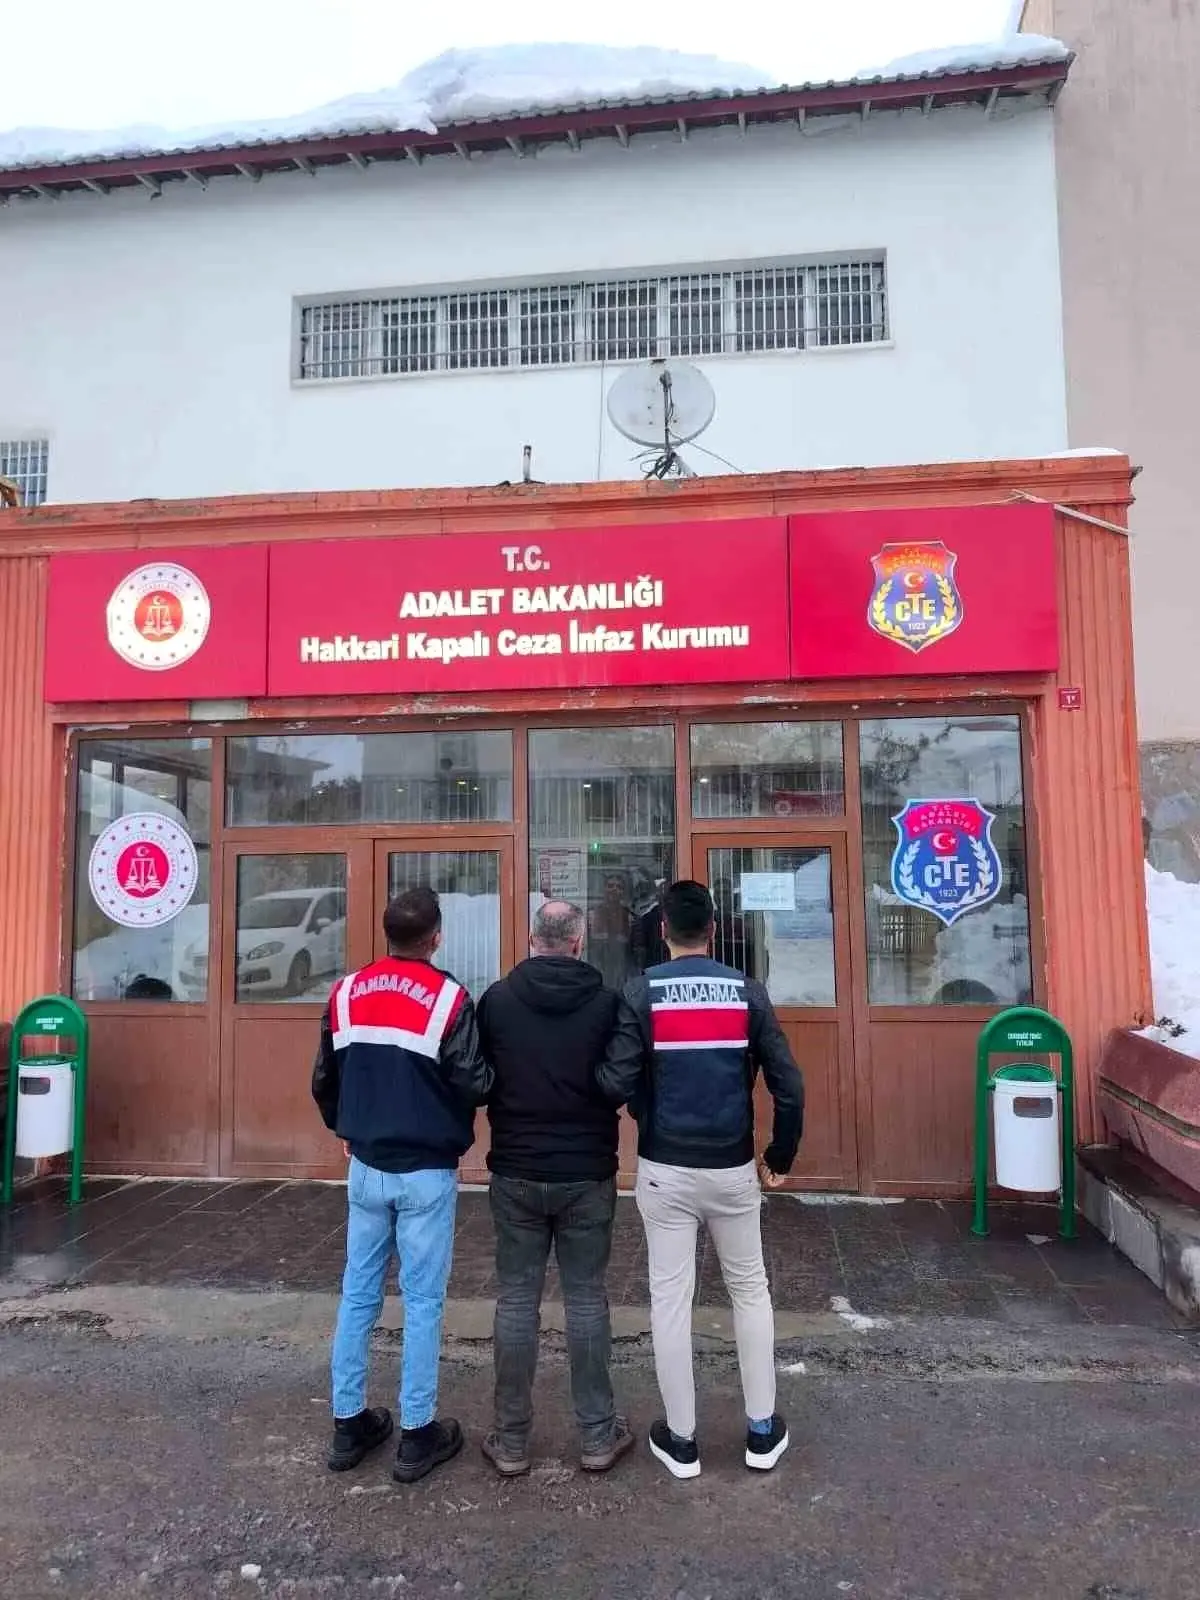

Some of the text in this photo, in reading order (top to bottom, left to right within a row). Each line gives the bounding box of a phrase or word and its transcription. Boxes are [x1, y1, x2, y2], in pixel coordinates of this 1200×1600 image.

[501, 545, 550, 571] T.C.
[400, 575, 663, 618] ADALET BAKANLIĞI
[895, 593, 936, 622] CTE
[300, 634, 399, 663] Hakkari
[407, 630, 489, 664] Kapalı
[497, 628, 562, 655] Ceza
[642, 622, 749, 650] Kurumu
[924, 856, 970, 887] CTE
[350, 973, 437, 1010] JANDARMA
[661, 983, 740, 1003] JANDARMA
